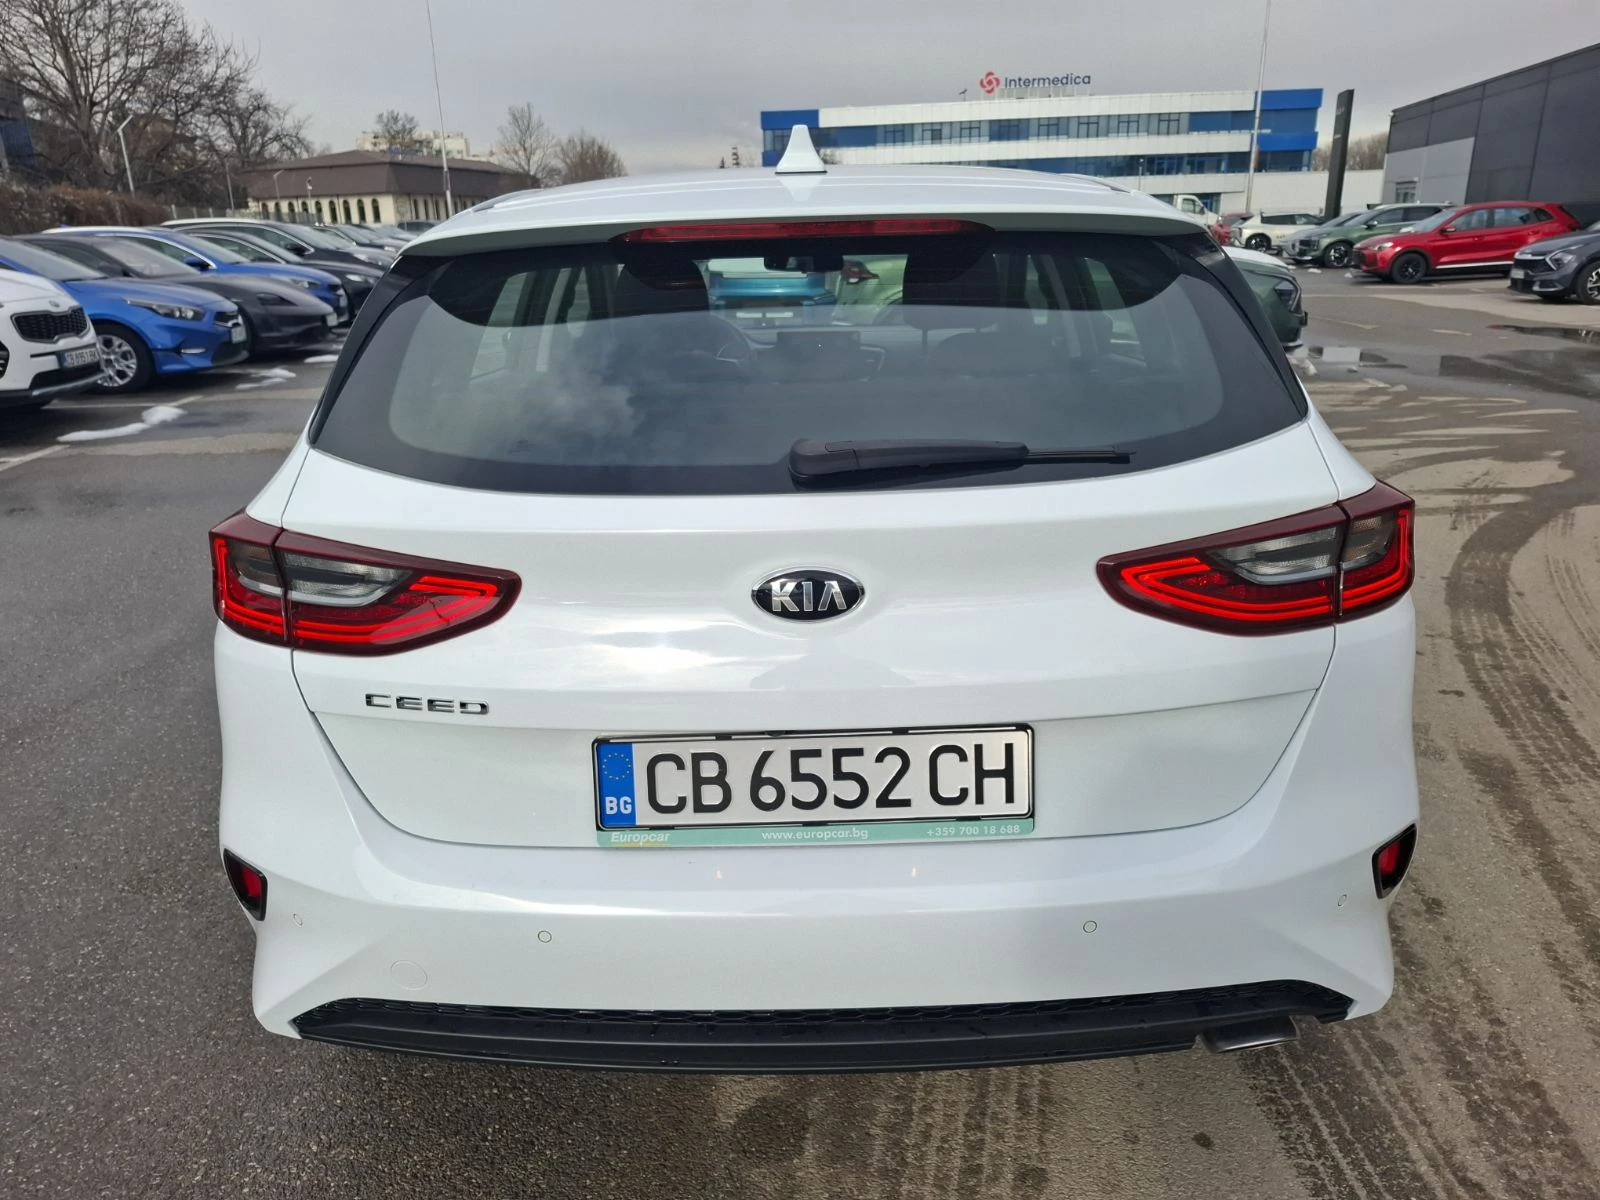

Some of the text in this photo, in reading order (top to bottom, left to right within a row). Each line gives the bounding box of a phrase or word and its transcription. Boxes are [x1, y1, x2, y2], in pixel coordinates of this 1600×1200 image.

[1004, 73, 1092, 88] Intermedica
[769, 579, 847, 612] KIA
[365, 693, 489, 715] CEED
[646, 742, 1015, 814] CB 6552 CH
[605, 797, 632, 814] BG
[761, 827, 869, 841] www.europcar.bg
[926, 824, 1021, 838] +359 700 18 688
[610, 832, 670, 847] Europcar
